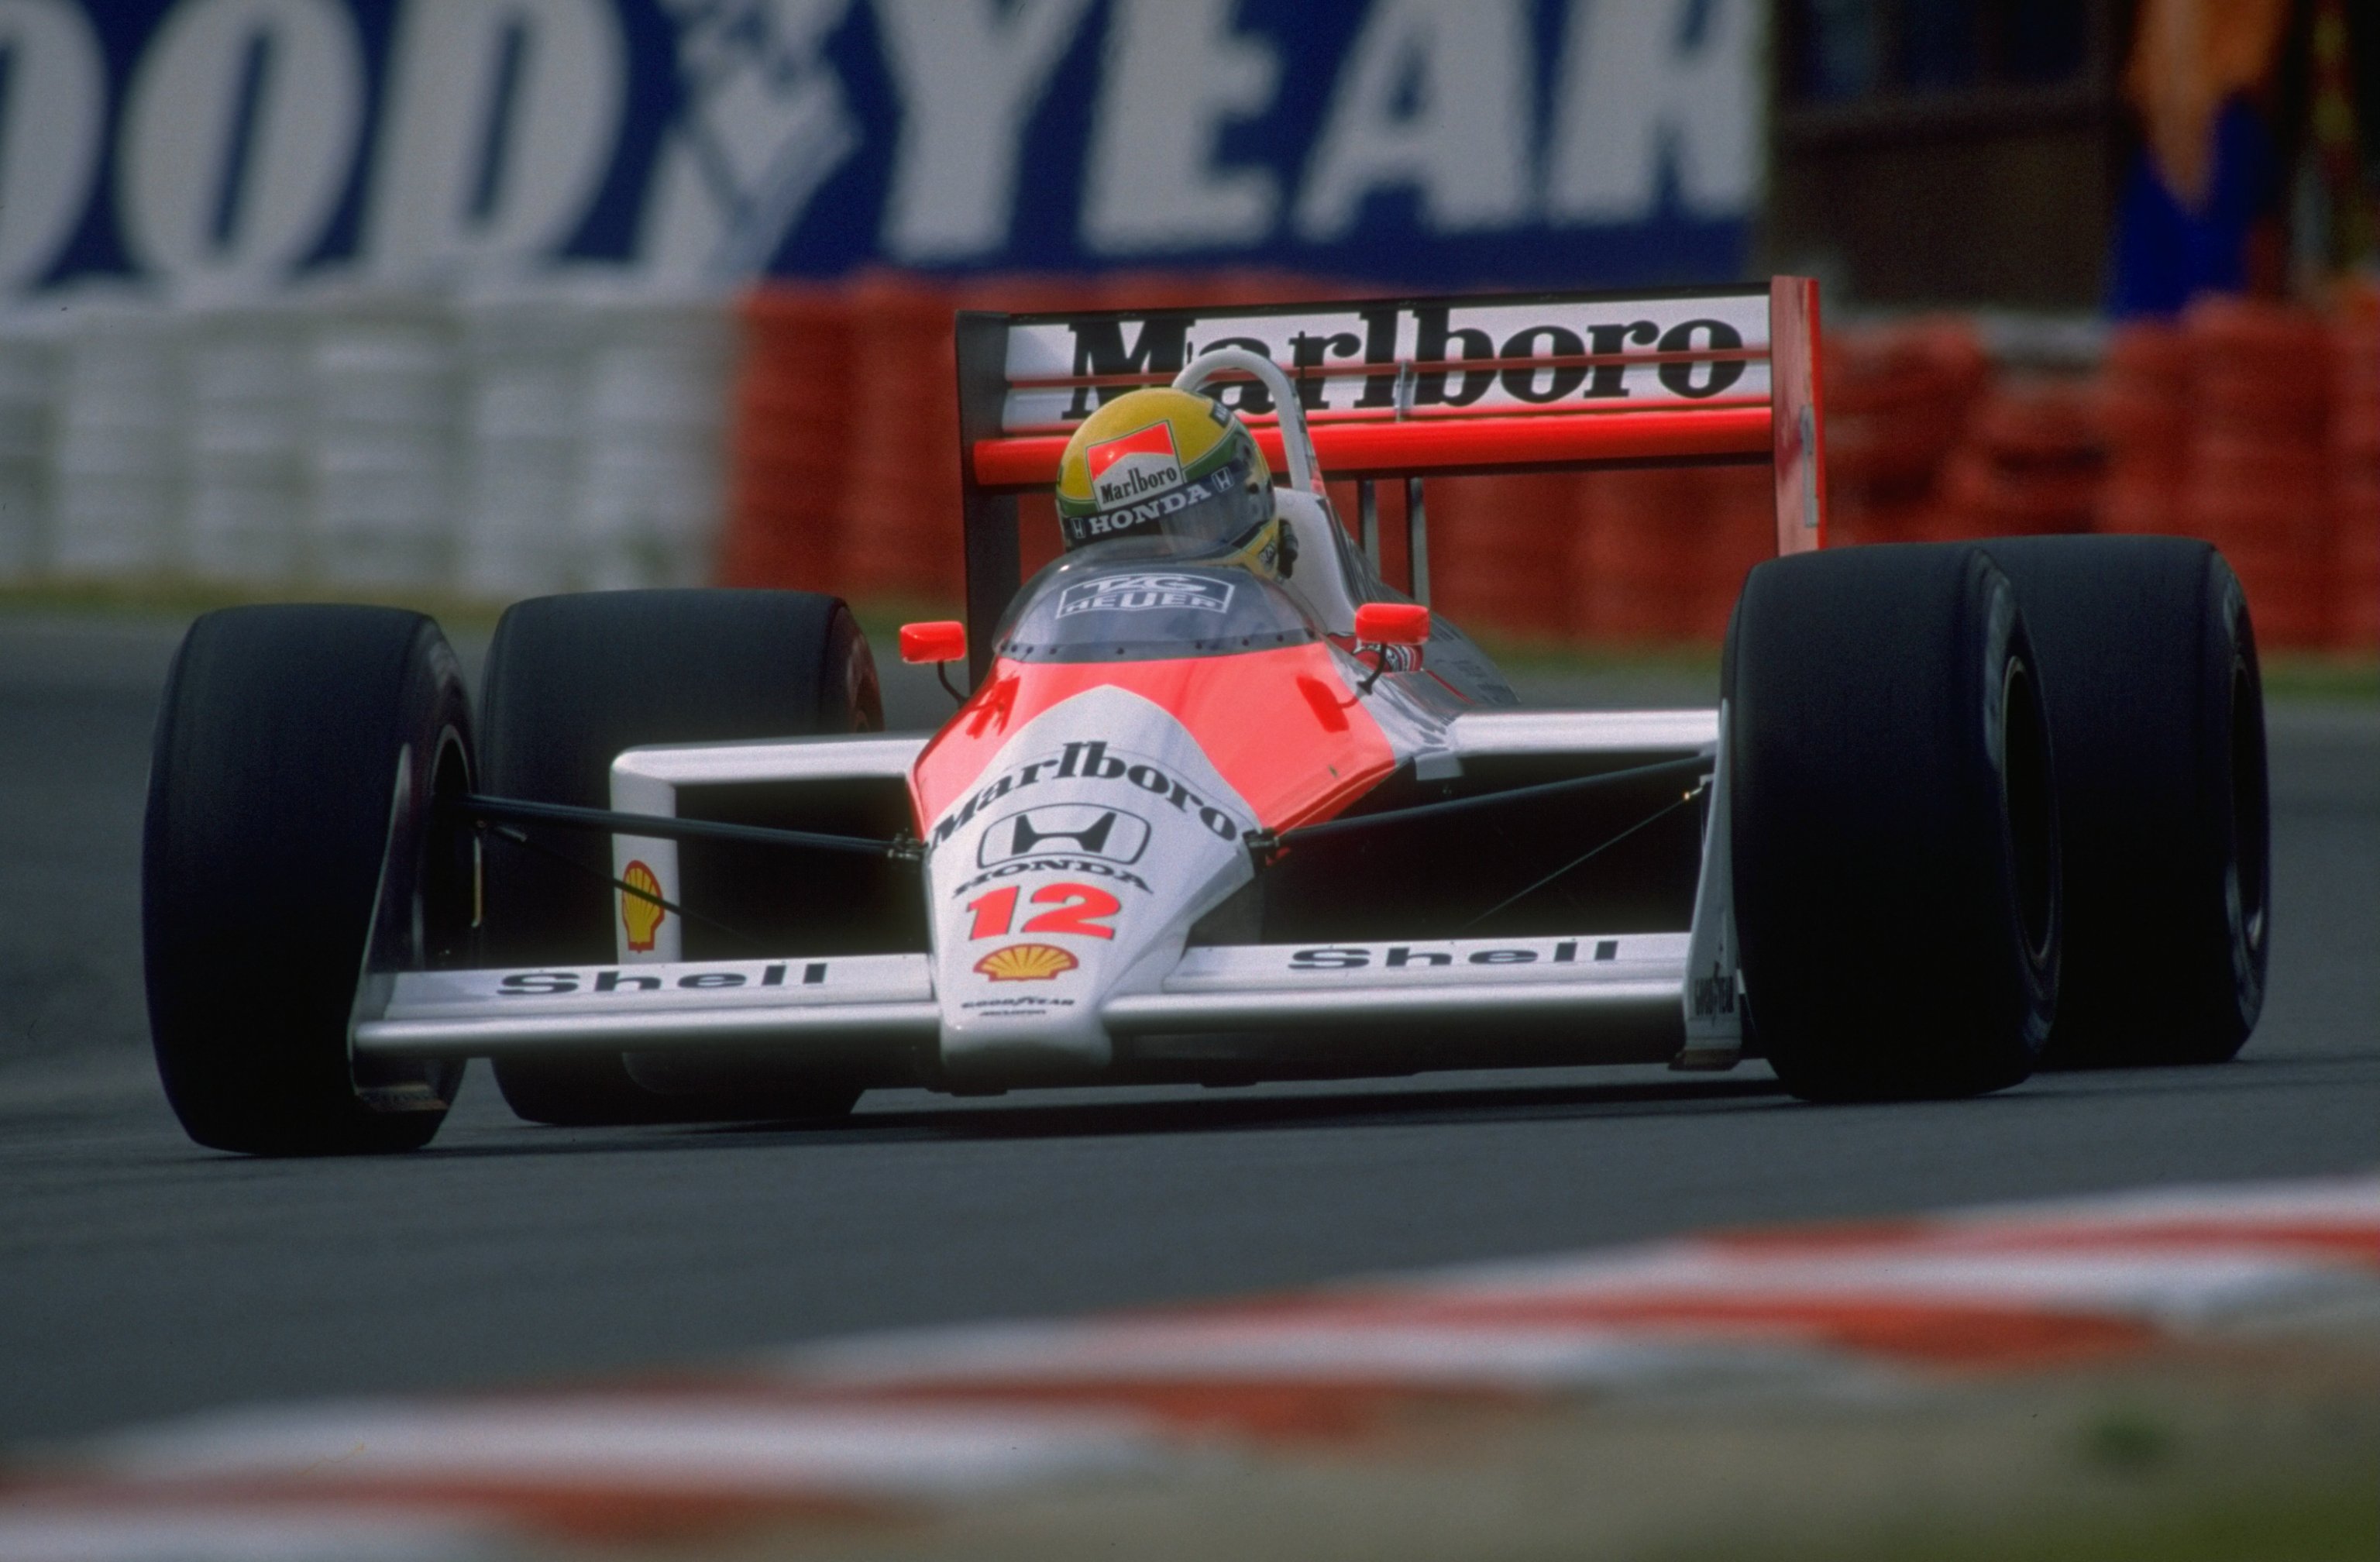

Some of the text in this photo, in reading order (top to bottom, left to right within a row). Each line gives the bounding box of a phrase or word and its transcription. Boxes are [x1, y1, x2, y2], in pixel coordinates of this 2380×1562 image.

[1100, 466, 1178, 504] Marlboro
[1089, 483, 1212, 535] HONDA
[1066, 592, 1216, 613] HEUER
[1084, 576, 1206, 594] TAG
[930, 741, 1237, 852] Marlboro
[952, 859, 1154, 900] HONDA
[967, 882, 1121, 941] 12
[1288, 940, 1618, 970] Shell
[497, 962, 828, 996] Shell
